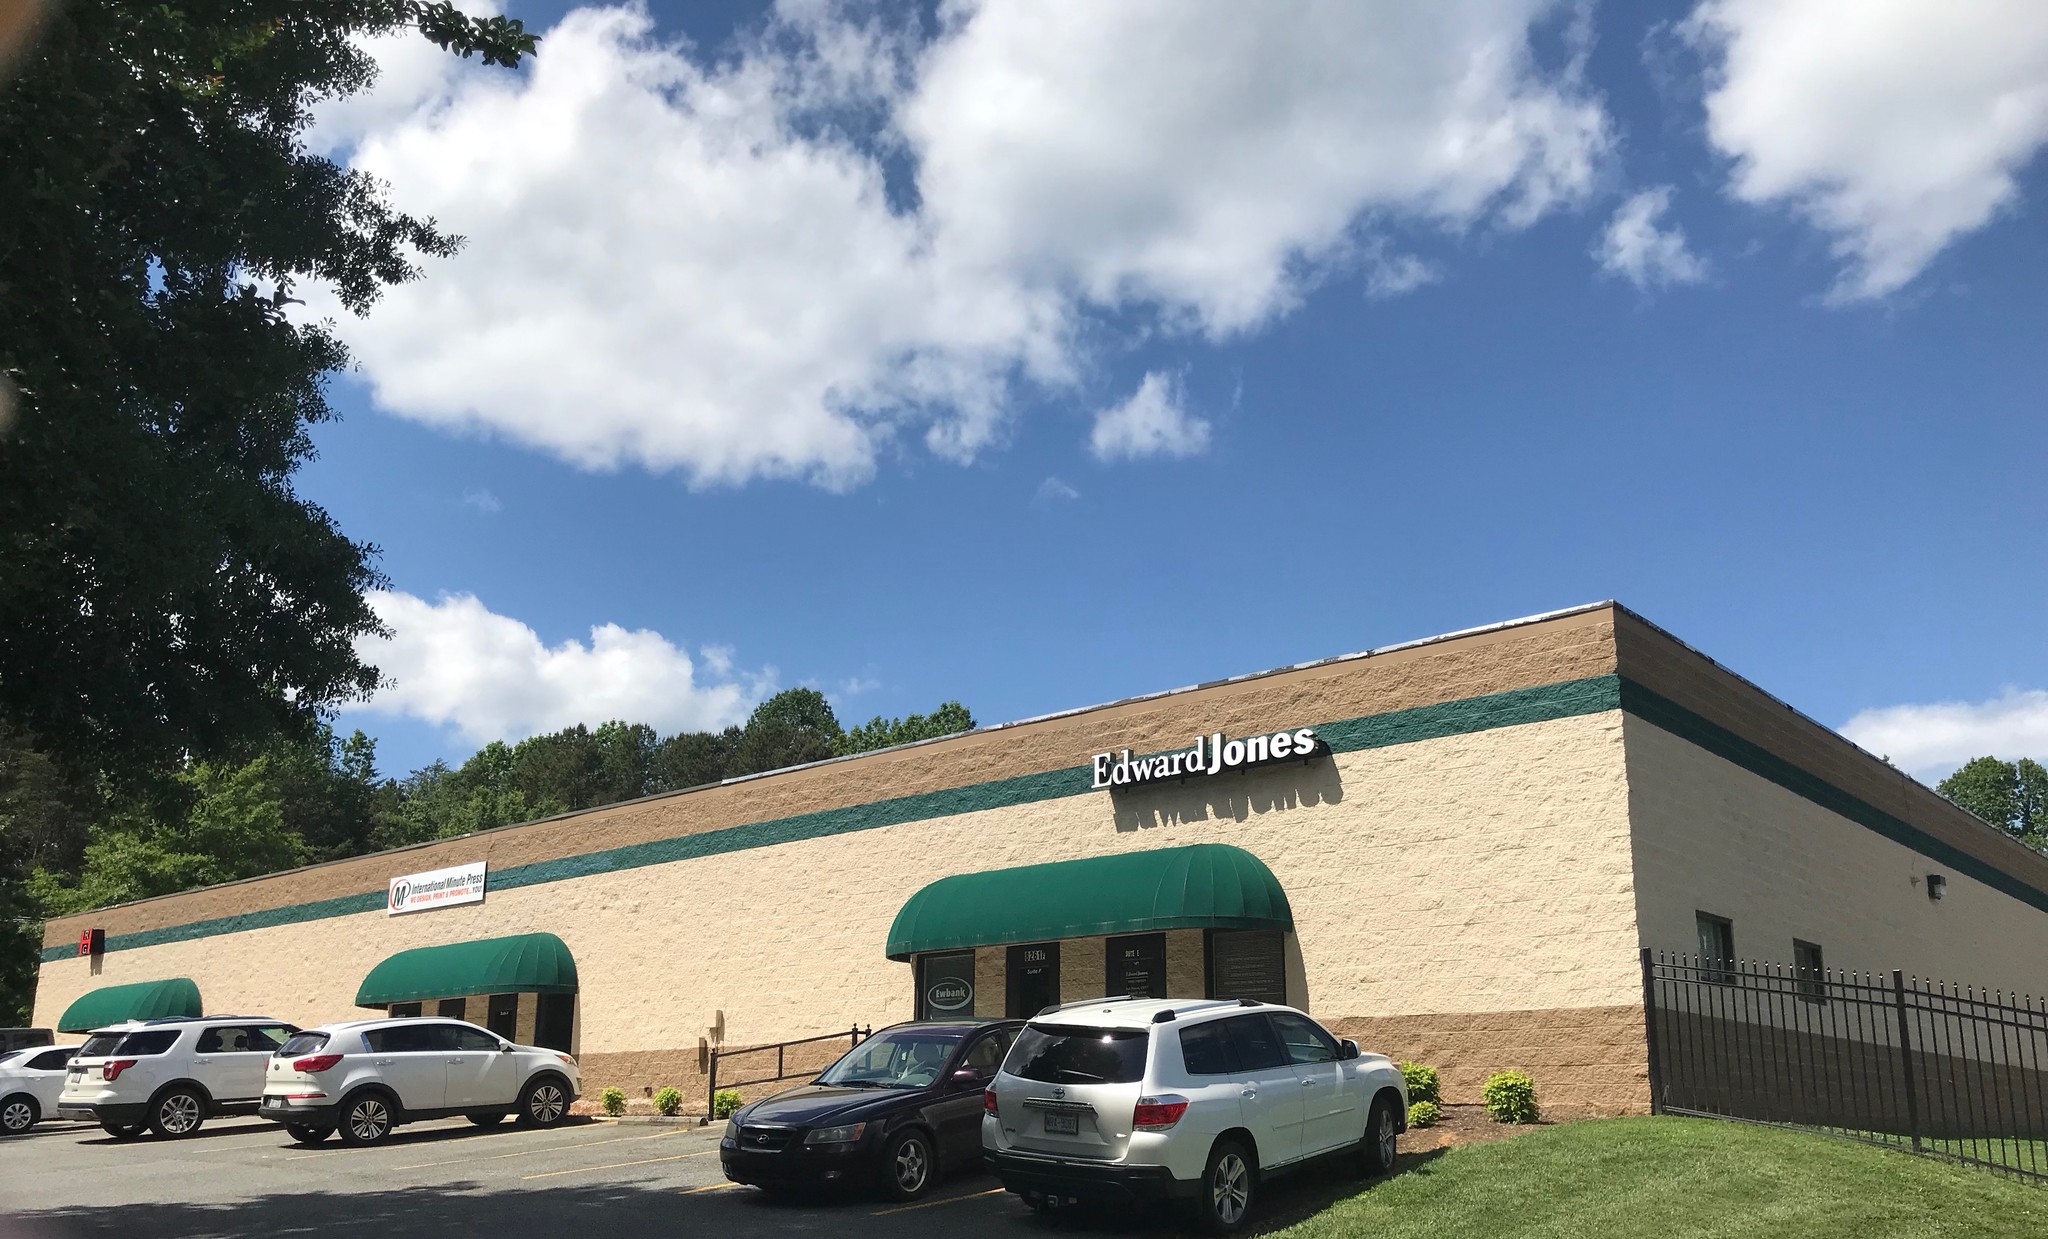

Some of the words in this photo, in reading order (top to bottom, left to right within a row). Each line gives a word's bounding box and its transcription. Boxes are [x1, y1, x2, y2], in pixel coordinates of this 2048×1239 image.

[411, 878, 446, 895] International
[446, 876, 466, 889] Minute
[466, 873, 483, 886] Press
[84, 930, 90, 940] R
[82, 944, 88, 954] G
[935, 986, 966, 998] Ewbank
